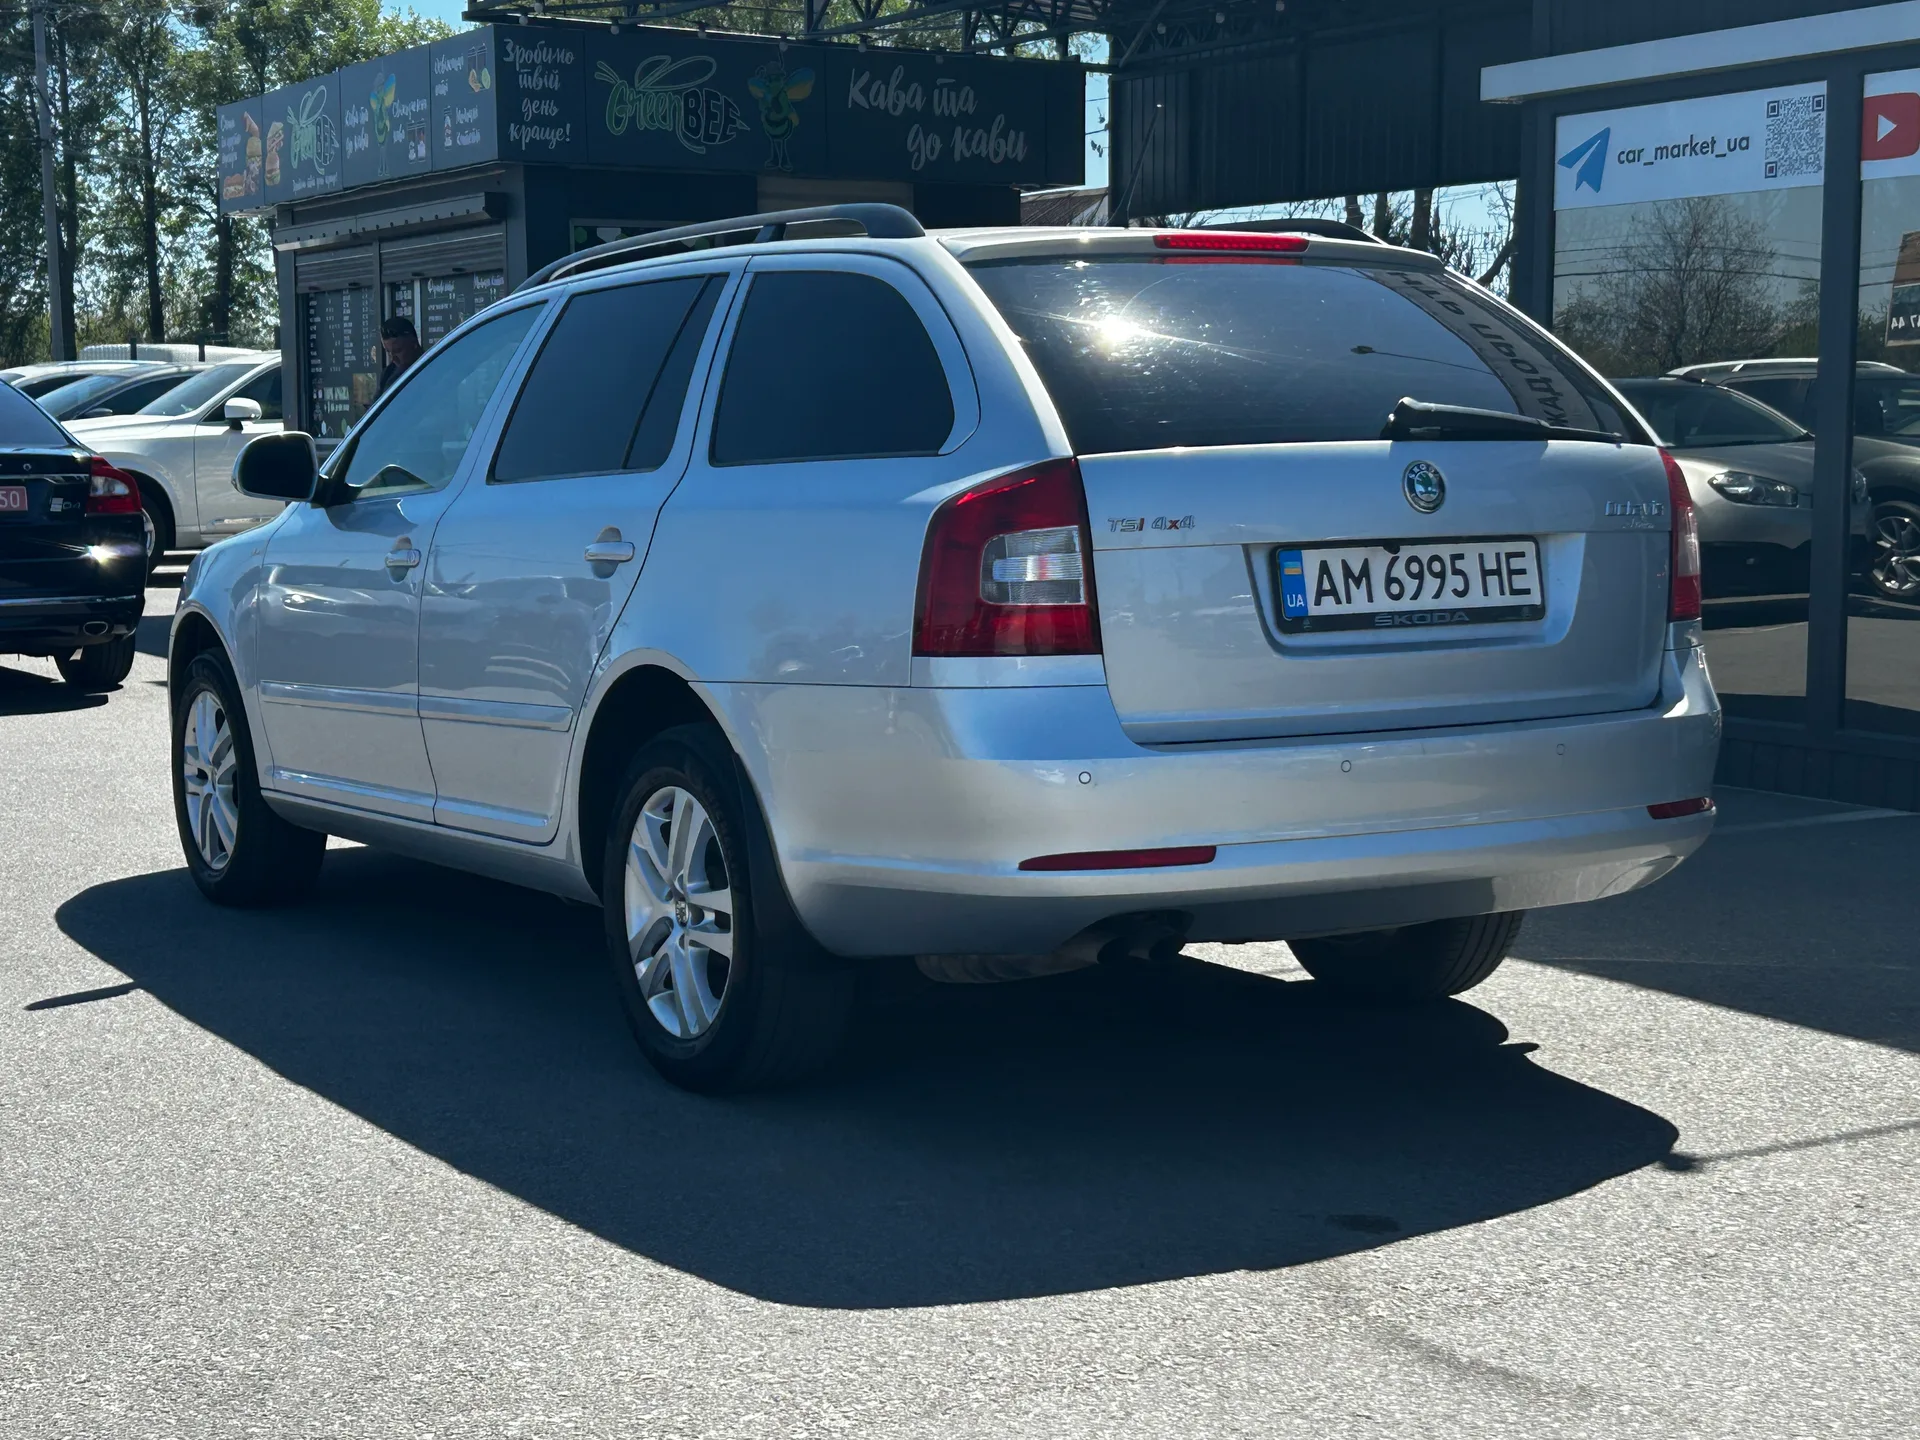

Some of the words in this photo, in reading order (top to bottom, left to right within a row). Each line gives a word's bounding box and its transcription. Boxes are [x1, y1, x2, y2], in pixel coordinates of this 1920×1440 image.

[503, 38, 575, 71] Зробимо
[518, 65, 561, 91] твій
[848, 65, 926, 116] Кава
[933, 78, 978, 117] та
[522, 96, 559, 123] день
[509, 123, 571, 150] краще!
[907, 123, 943, 172] до
[950, 113, 1027, 164] кави
[1617, 134, 1750, 166] car_market_ua
[1107, 516, 1145, 533] TSI
[1151, 514, 1196, 531] 4x4
[1313, 557, 1374, 607] AM
[1384, 552, 1470, 601] 6995
[1478, 551, 1532, 597] HE
[1287, 593, 1305, 608] UA
